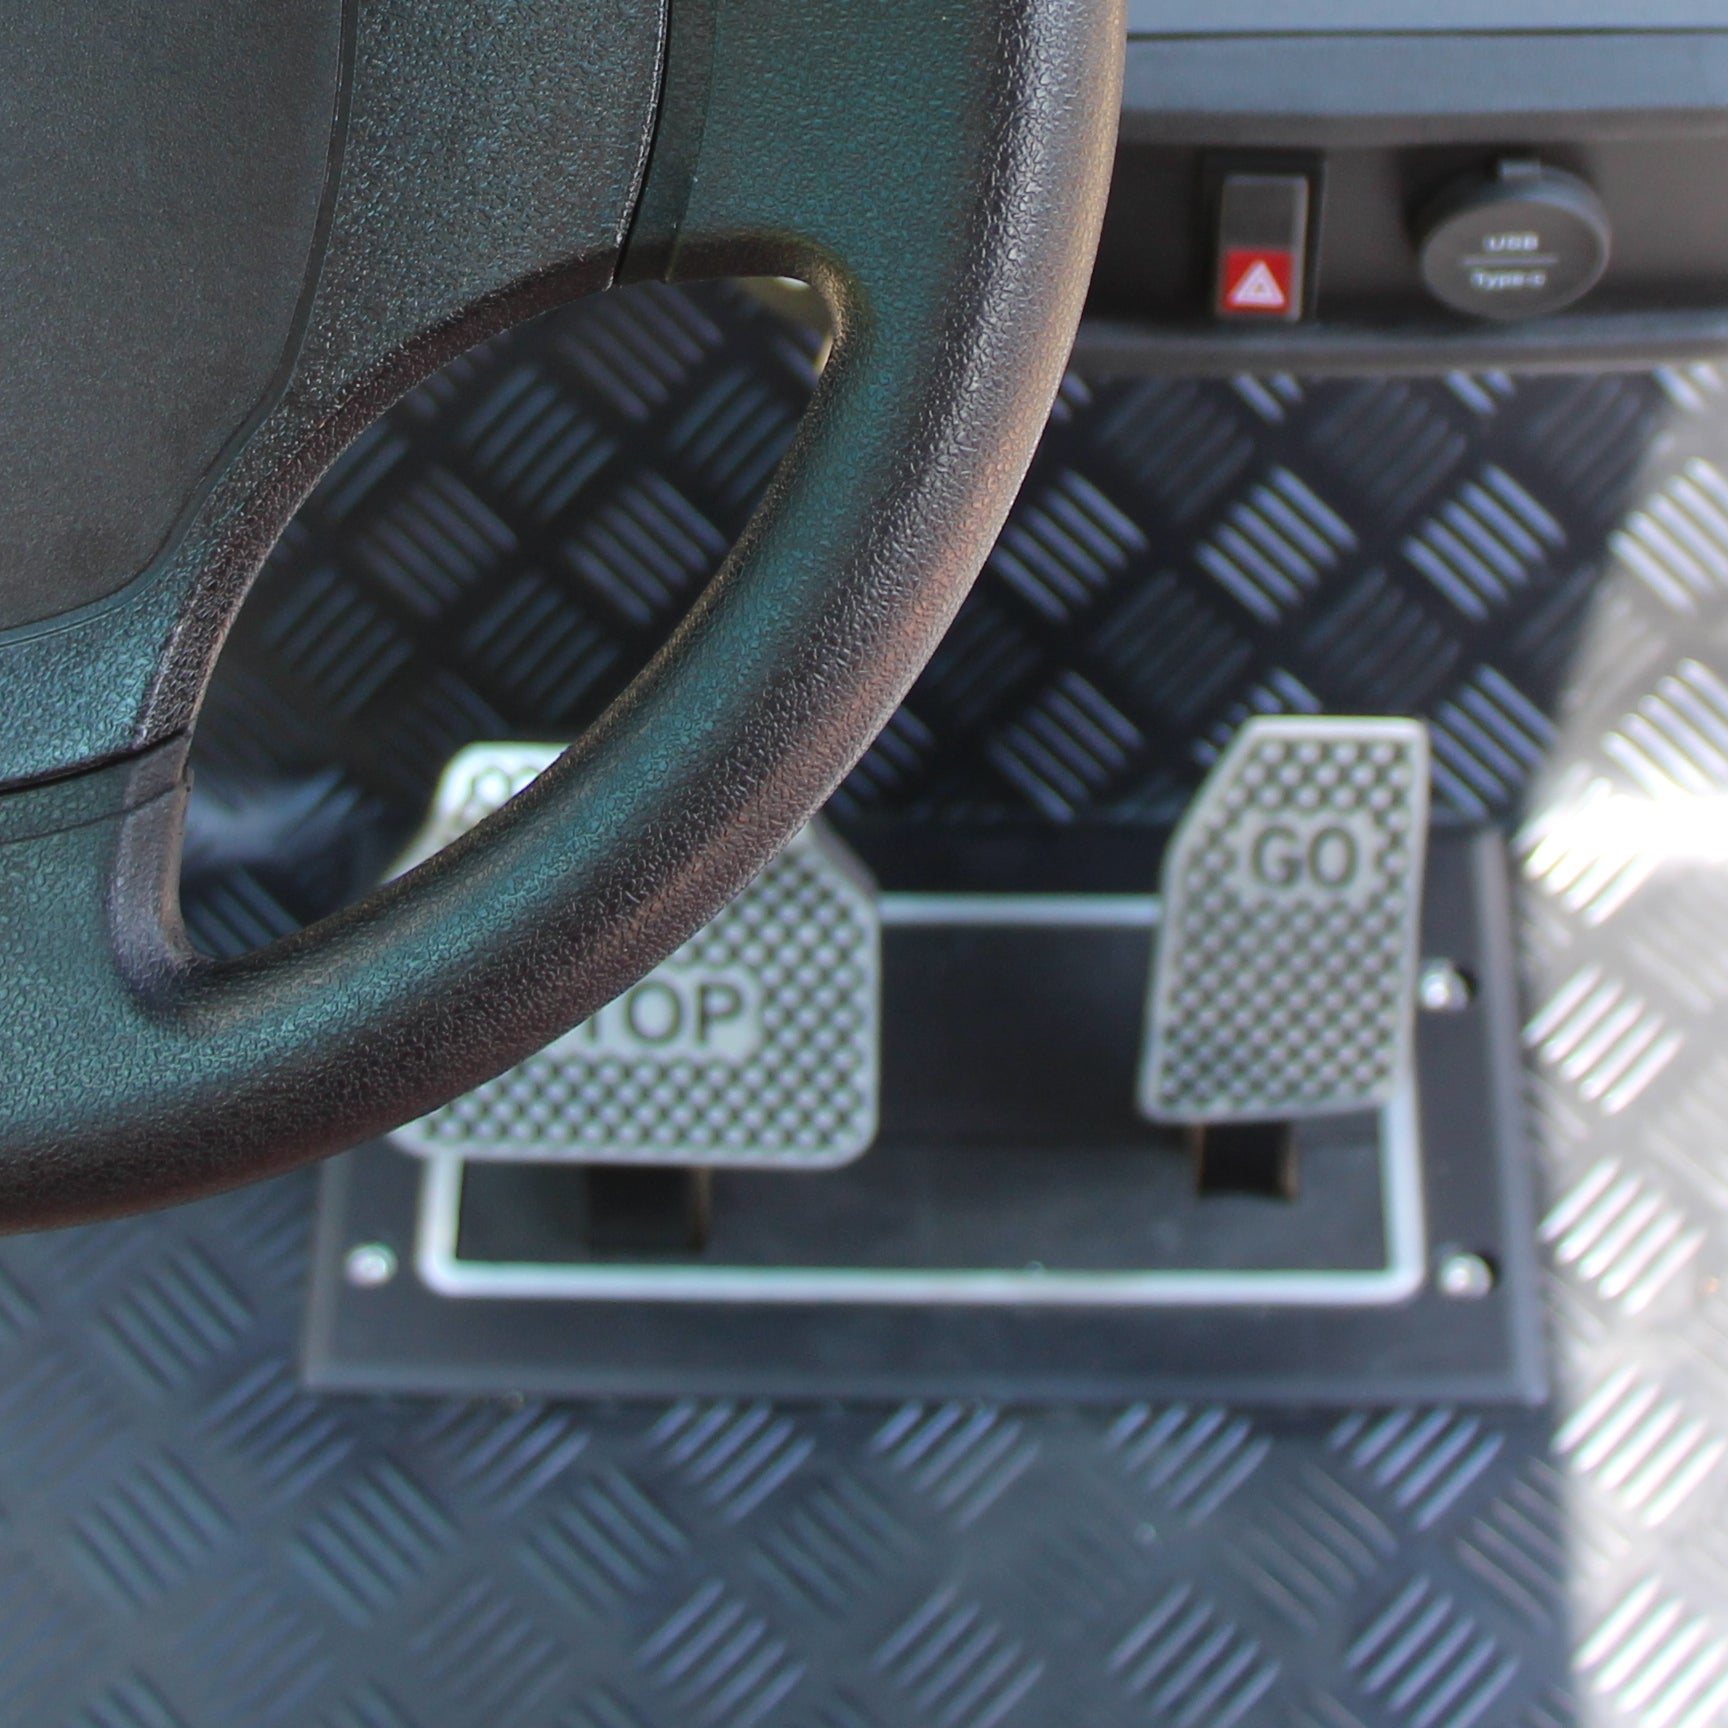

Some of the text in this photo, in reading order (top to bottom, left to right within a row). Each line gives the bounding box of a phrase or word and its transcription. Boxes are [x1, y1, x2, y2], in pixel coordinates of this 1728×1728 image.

[1484, 235, 1539, 252] USB
[1252, 825, 1358, 888] GO
[585, 980, 742, 1044] OP
